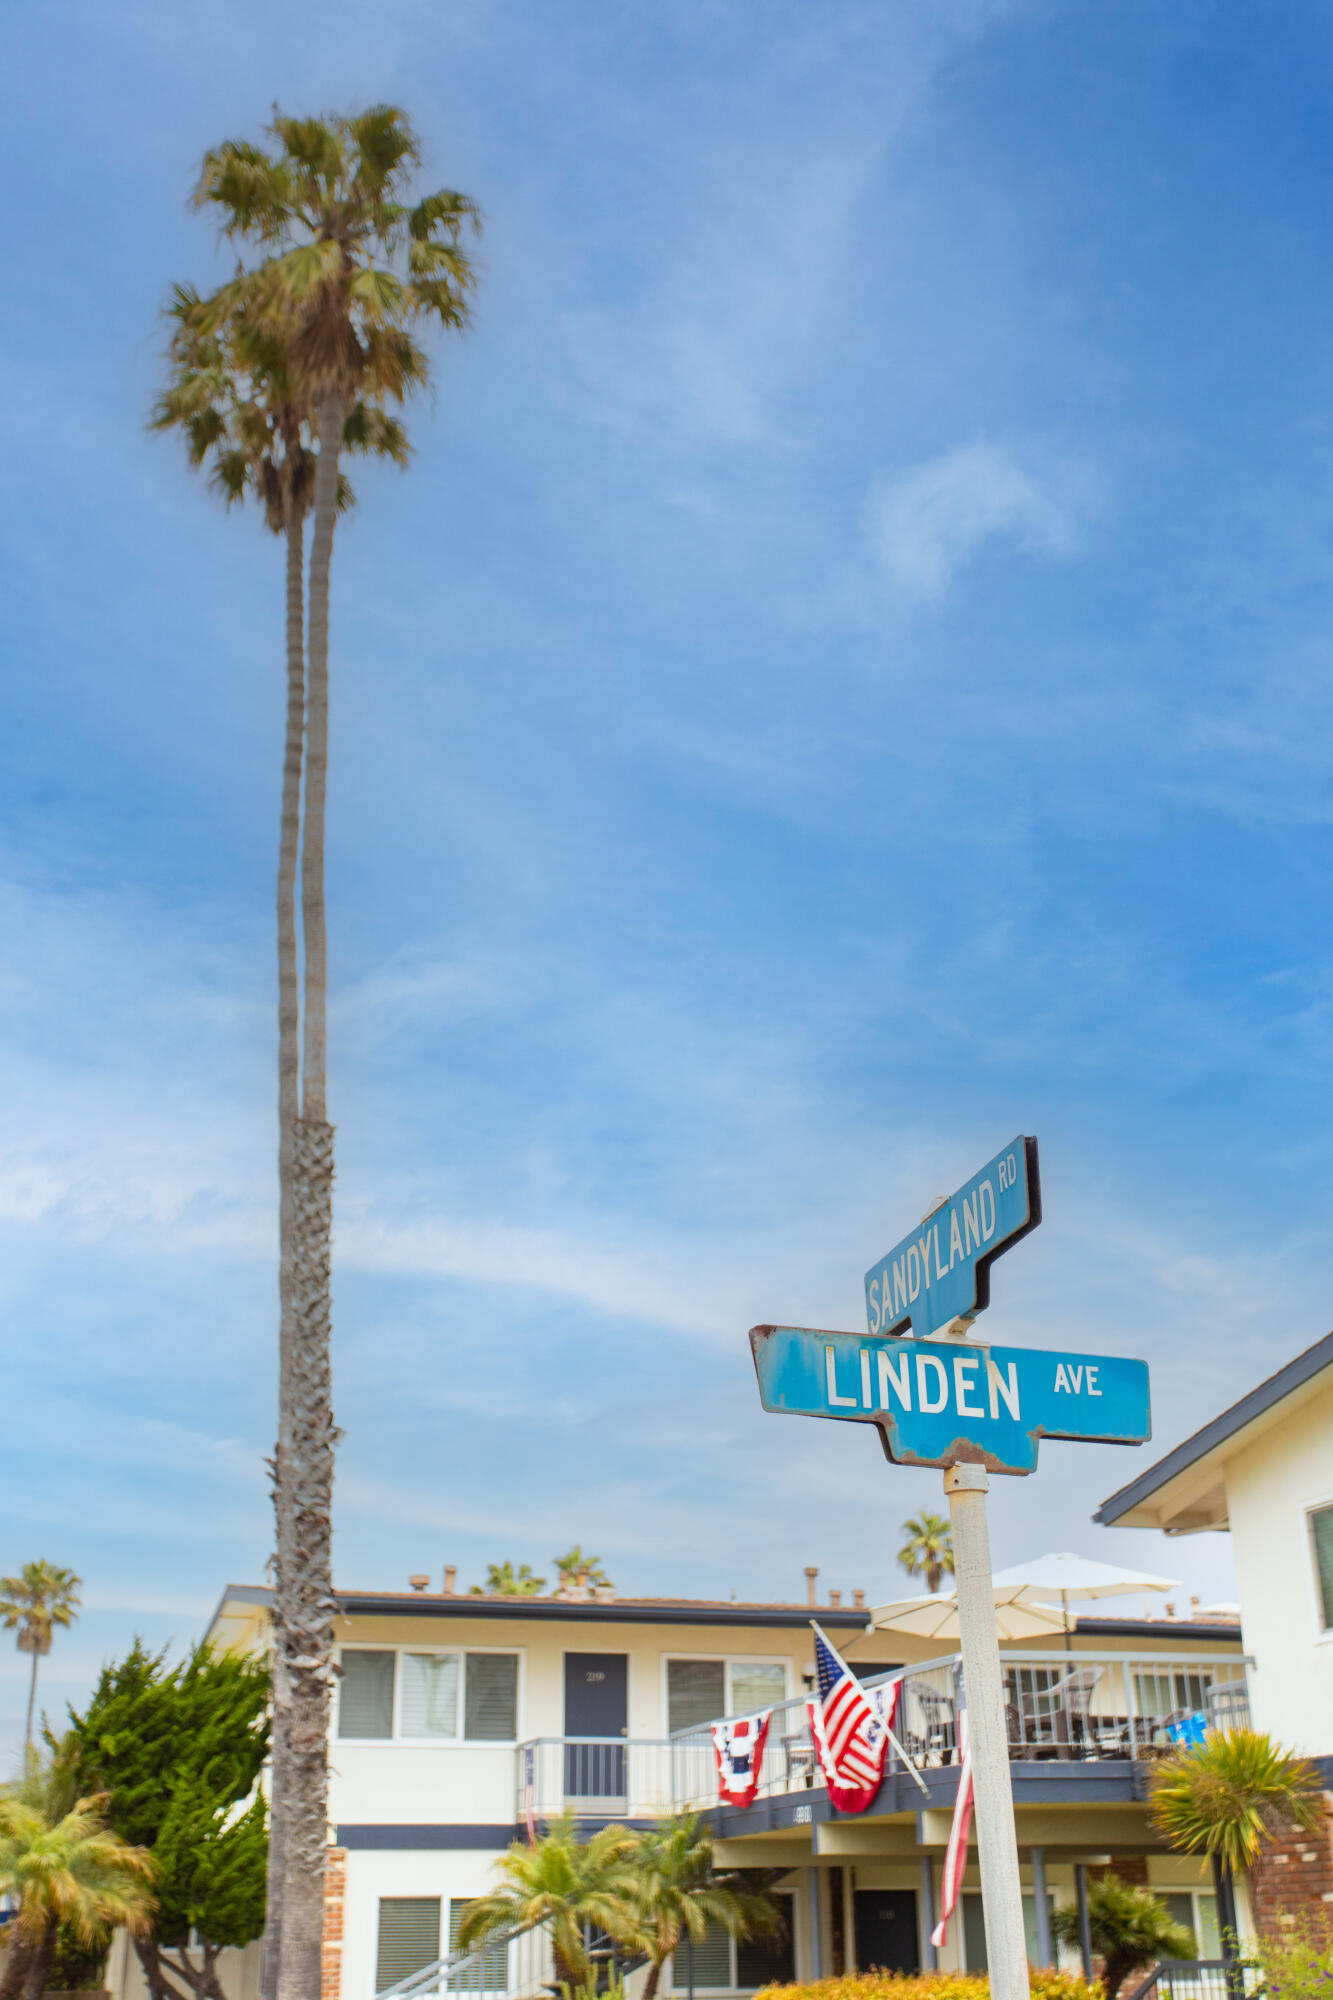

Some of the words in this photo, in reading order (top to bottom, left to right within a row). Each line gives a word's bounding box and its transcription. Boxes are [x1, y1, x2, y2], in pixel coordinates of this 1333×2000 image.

[869, 1178, 996, 1335] SANDYLAND
[998, 1153, 1017, 1193] RD
[825, 1345, 1021, 1421] LINDEN
[1053, 1363, 1103, 1396] AVE
